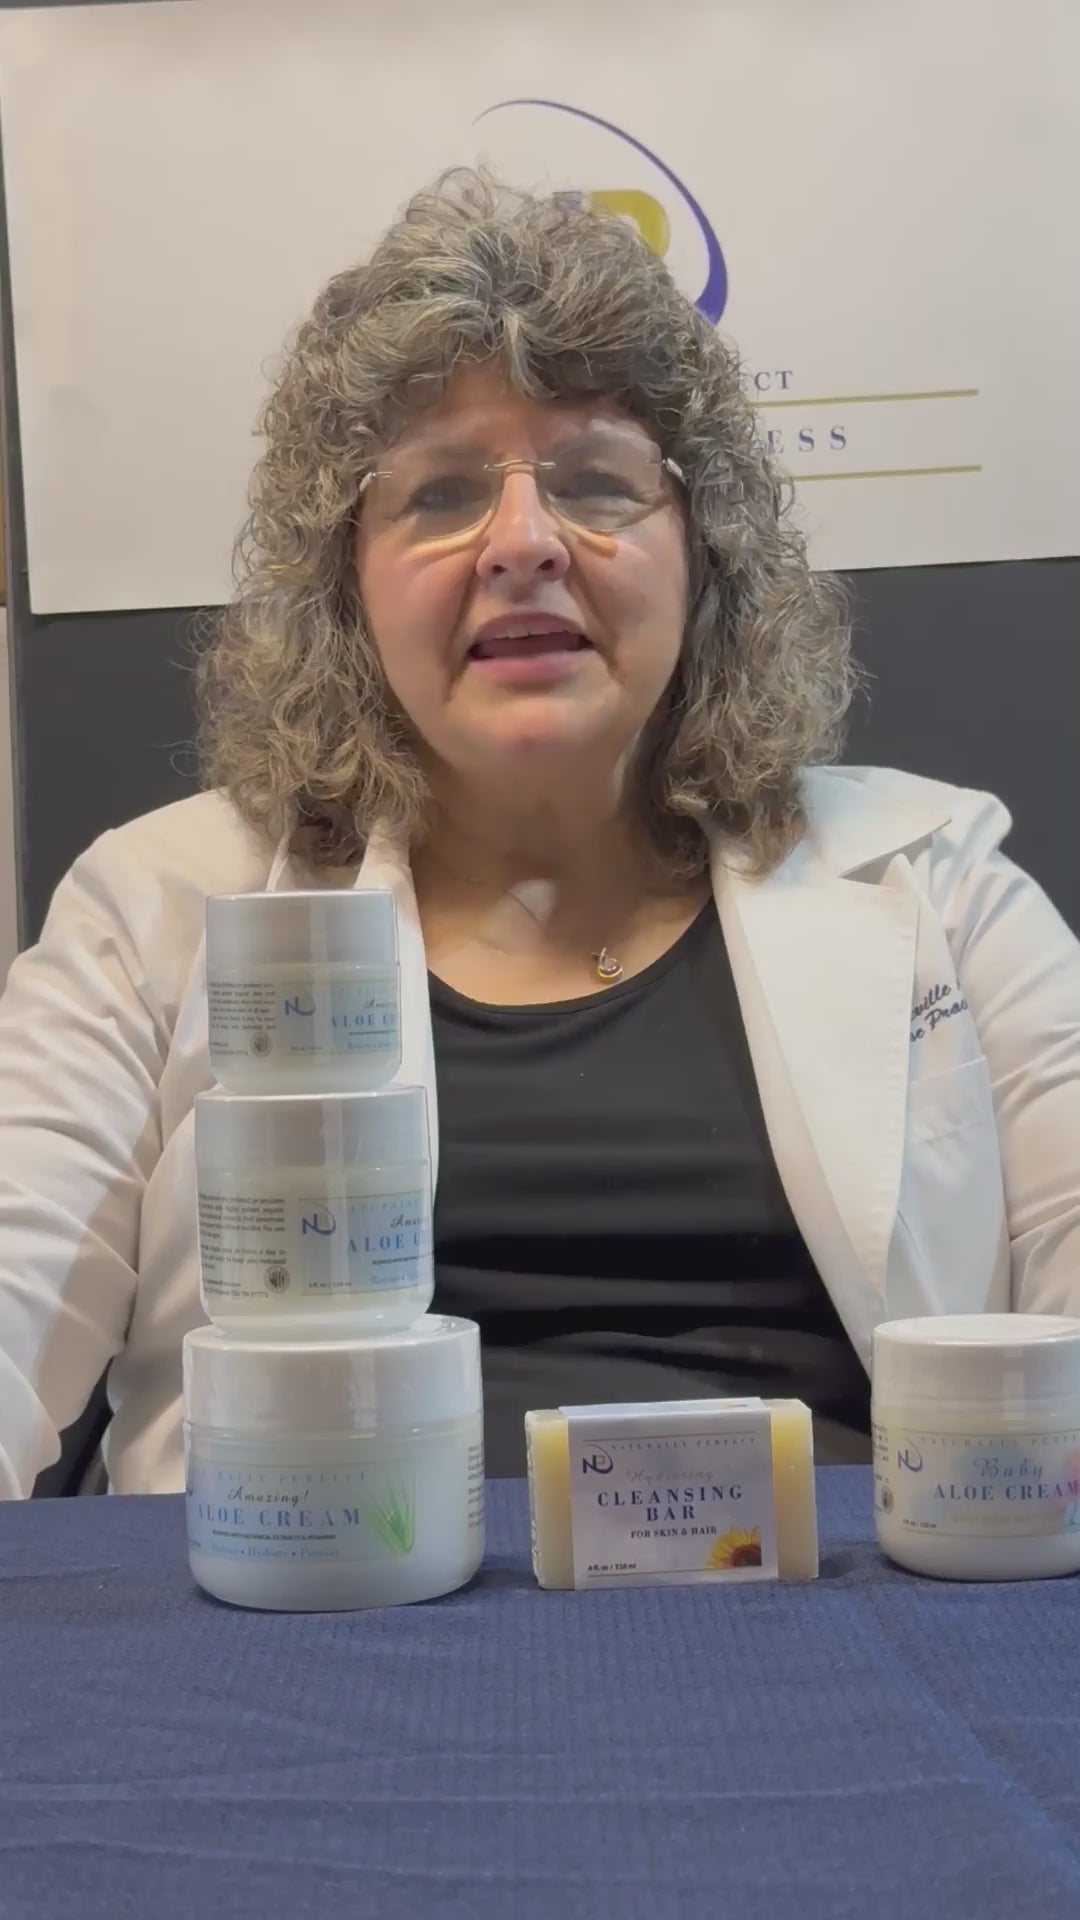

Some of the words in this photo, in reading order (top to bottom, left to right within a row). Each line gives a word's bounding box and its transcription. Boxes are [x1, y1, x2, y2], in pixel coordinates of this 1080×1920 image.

[348, 1234, 405, 1253] ALOE
[973, 1457, 1043, 1481] Baby
[227, 1485, 310, 1508] Amazing!
[597, 1484, 743, 1507] CLEANSING
[934, 1483, 995, 1501] ALOE
[1004, 1479, 1080, 1501] CREAM
[259, 1507, 360, 1528] CREAM
[647, 1504, 696, 1522] BAR
[630, 1530, 651, 1540] FOR
[653, 1528, 679, 1538] SKIN
[681, 1528, 688, 1536] &
[691, 1526, 717, 1536] HAIR
